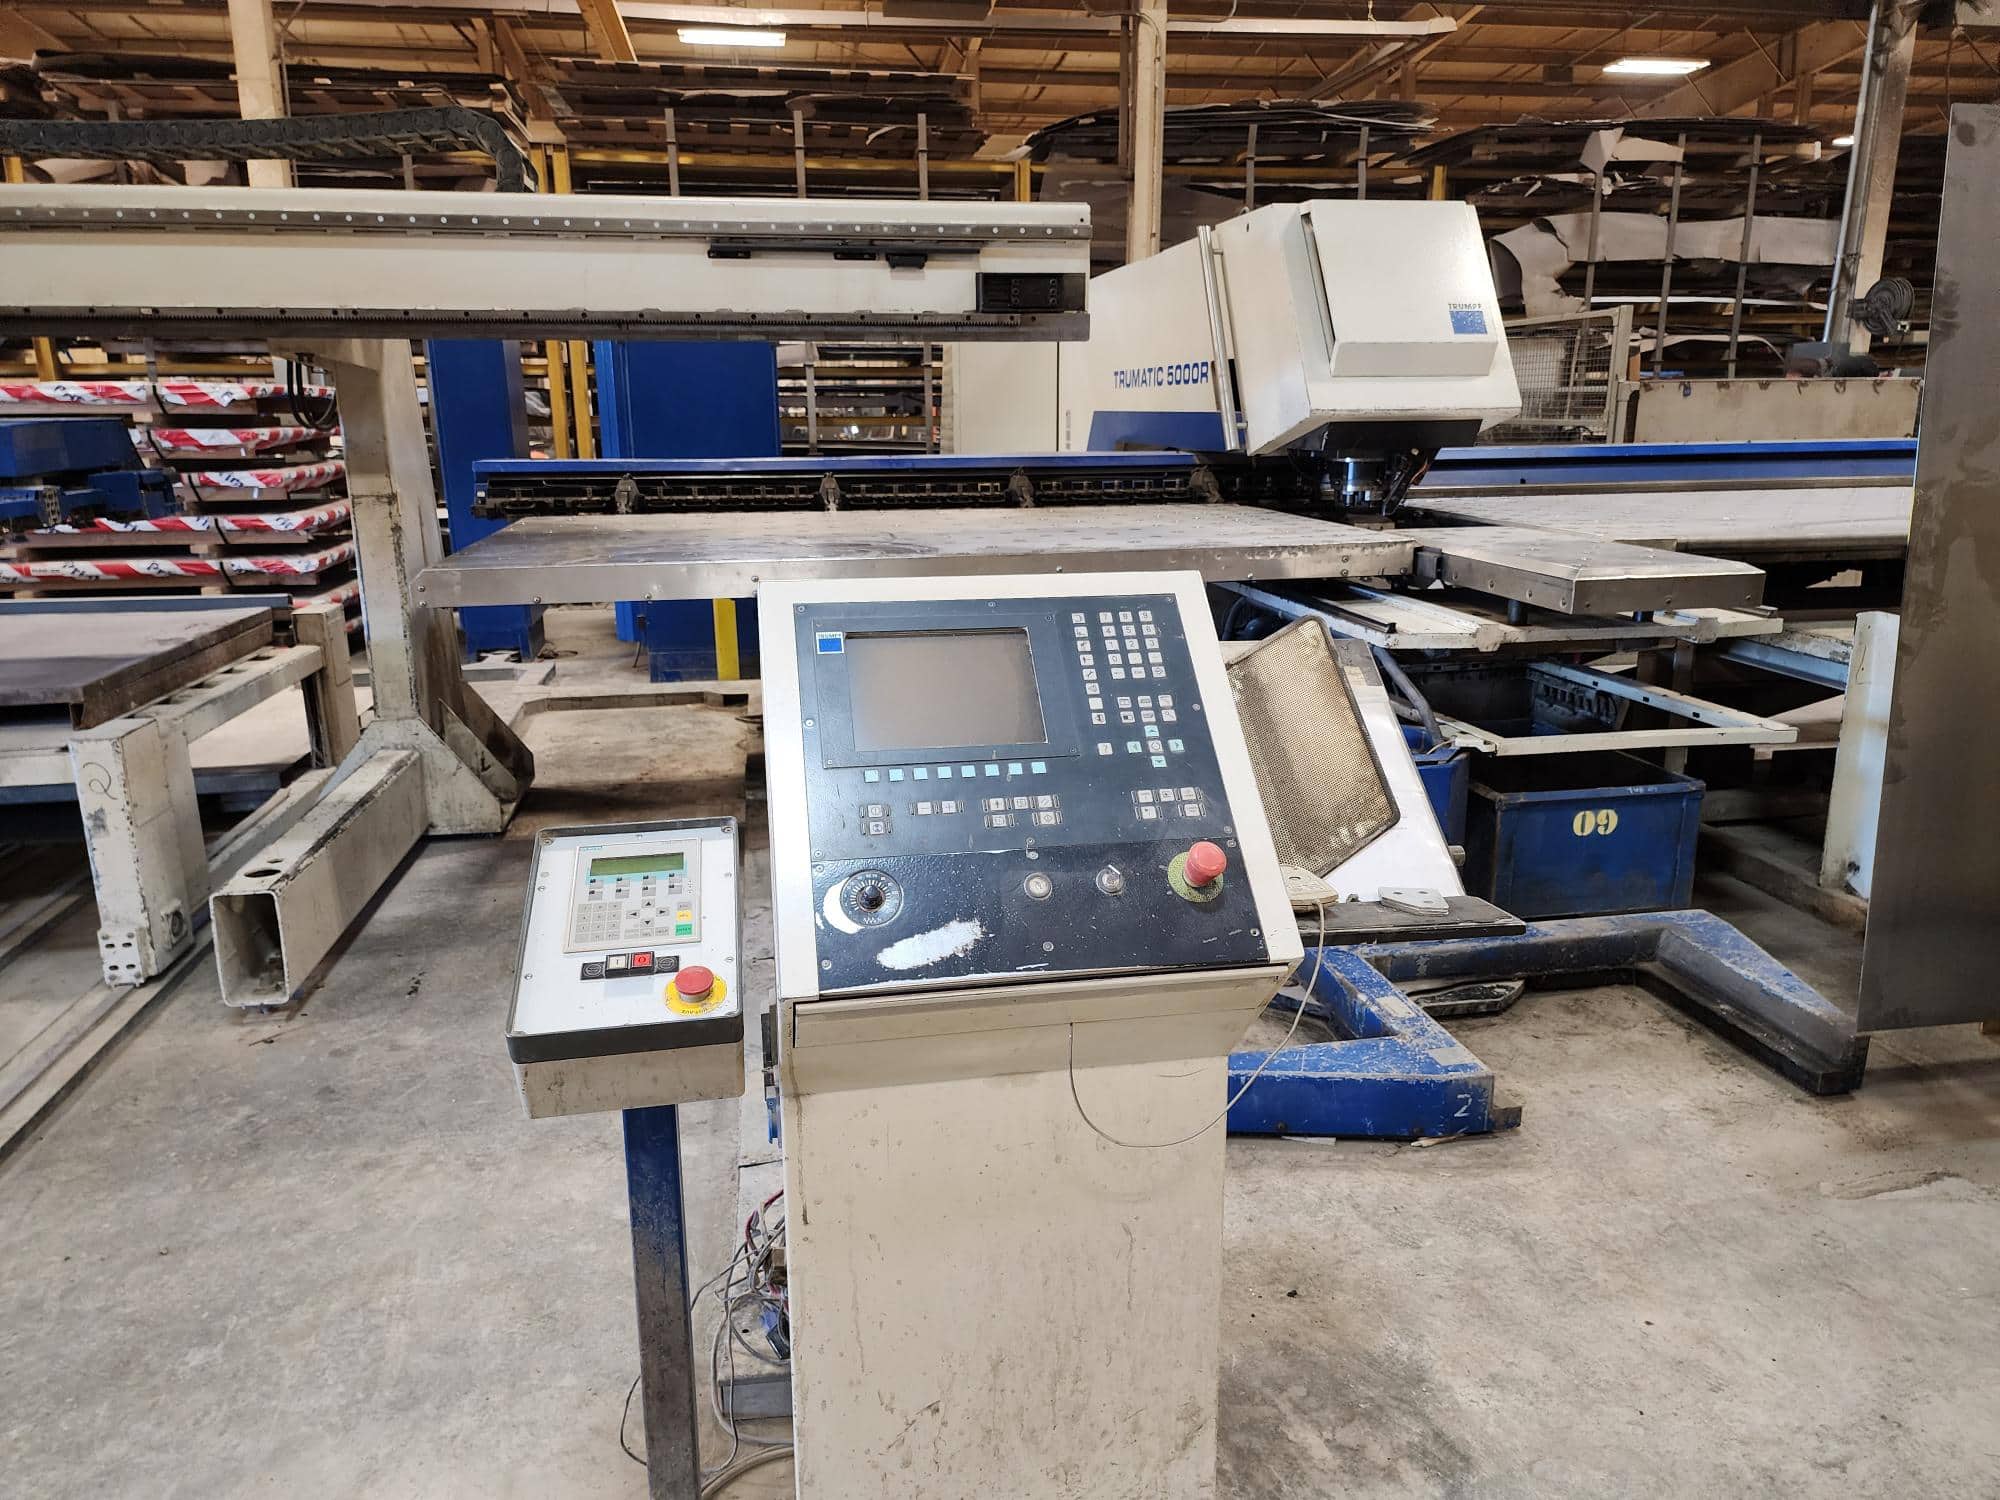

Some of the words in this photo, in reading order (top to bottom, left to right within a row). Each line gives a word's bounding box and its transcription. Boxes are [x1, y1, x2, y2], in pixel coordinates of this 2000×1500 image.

[1113, 367, 1164, 388] TRUMATIC
[1167, 361, 1209, 386] 5000R
[1572, 809, 1618, 836] 09
[1454, 1094, 1472, 1117] 2
